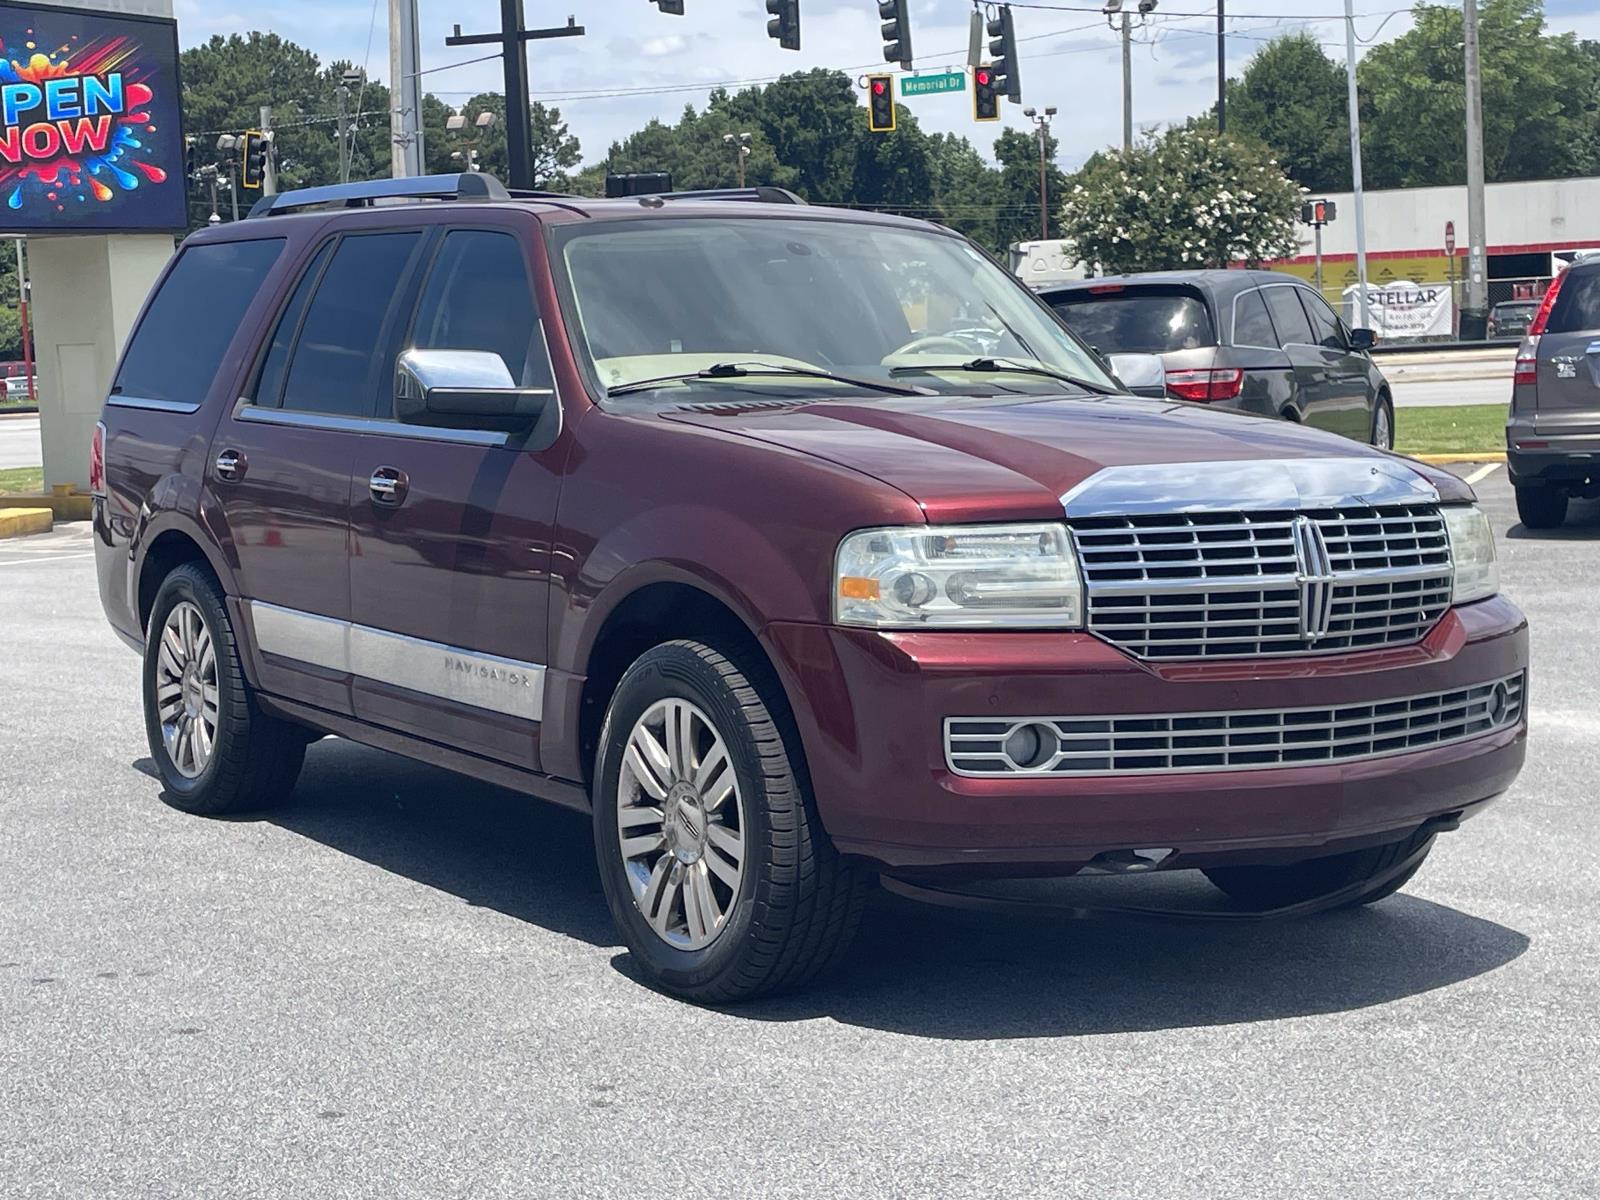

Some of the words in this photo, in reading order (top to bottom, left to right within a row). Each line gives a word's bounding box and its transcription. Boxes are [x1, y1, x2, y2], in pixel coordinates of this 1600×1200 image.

[1, 73, 123, 126] PEN
[906, 79, 947, 92] Memorial
[949, 77, 960, 88] Dr
[0, 115, 112, 163] NOW
[1367, 289, 1437, 306] STELLAR
[444, 656, 531, 688] NAVIGATOR
